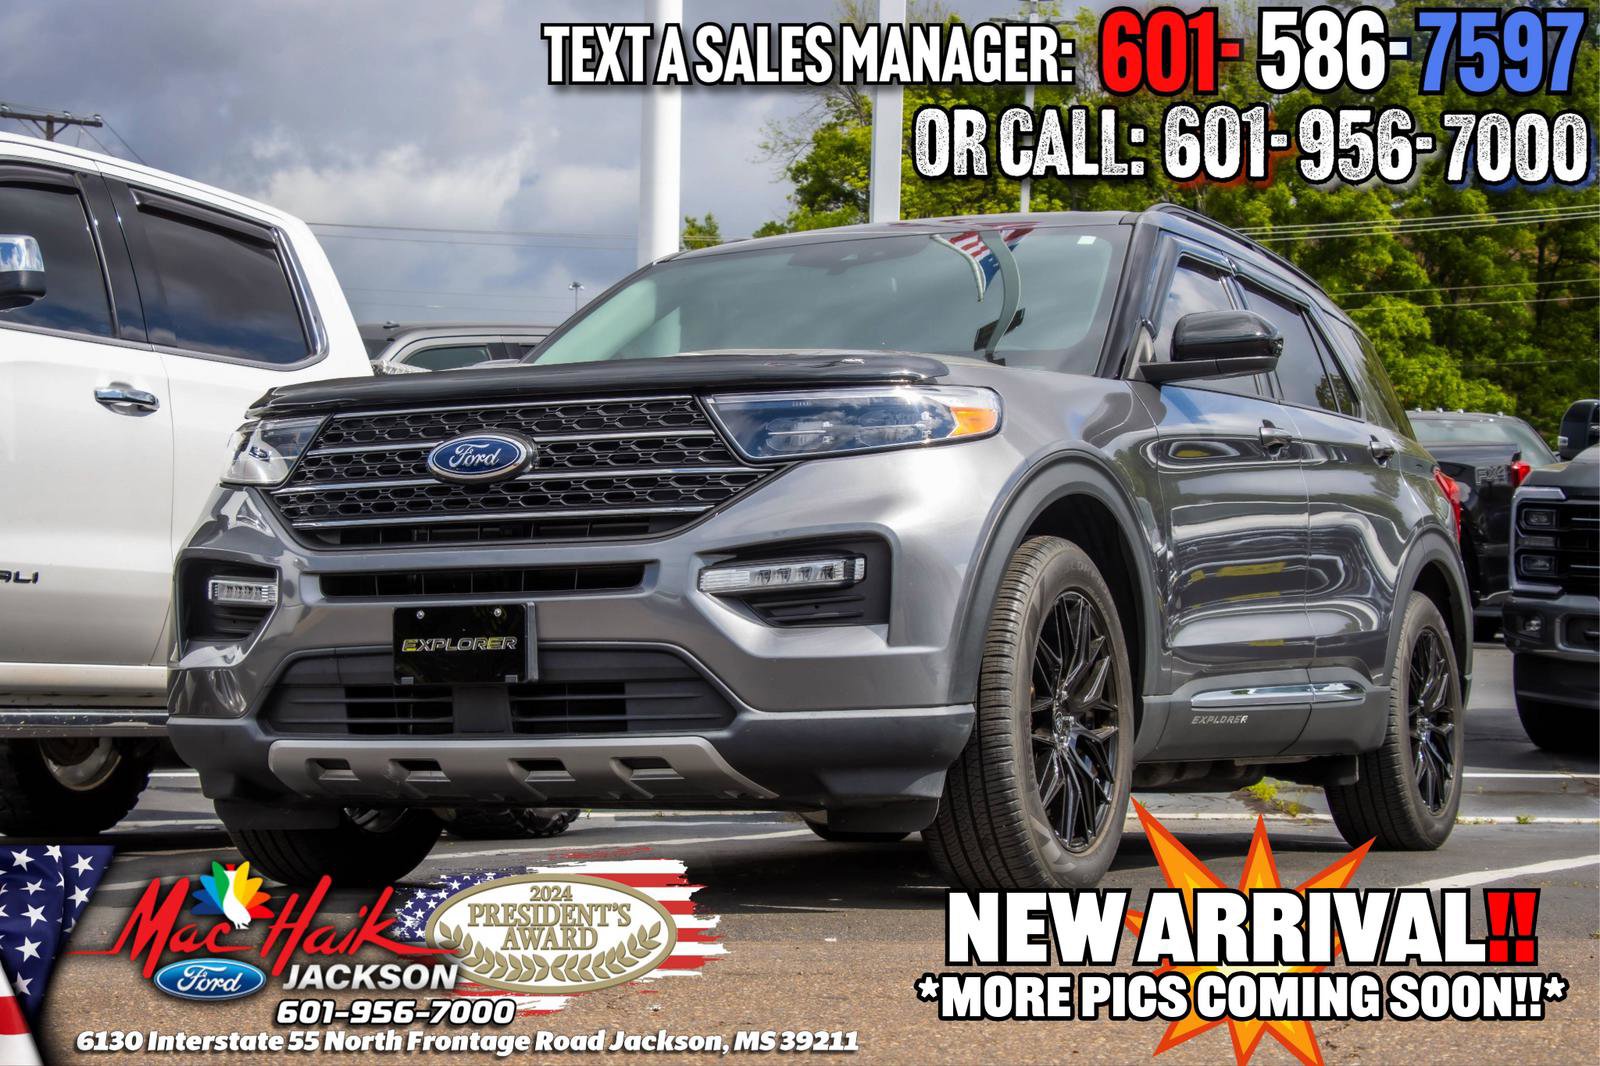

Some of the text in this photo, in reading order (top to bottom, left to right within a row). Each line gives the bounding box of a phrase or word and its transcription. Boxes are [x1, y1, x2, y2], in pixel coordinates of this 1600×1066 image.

[449, 443, 502, 468] Ford
[402, 636, 518, 652] EXPLORER
[1191, 715, 1249, 725] EXPLORER
